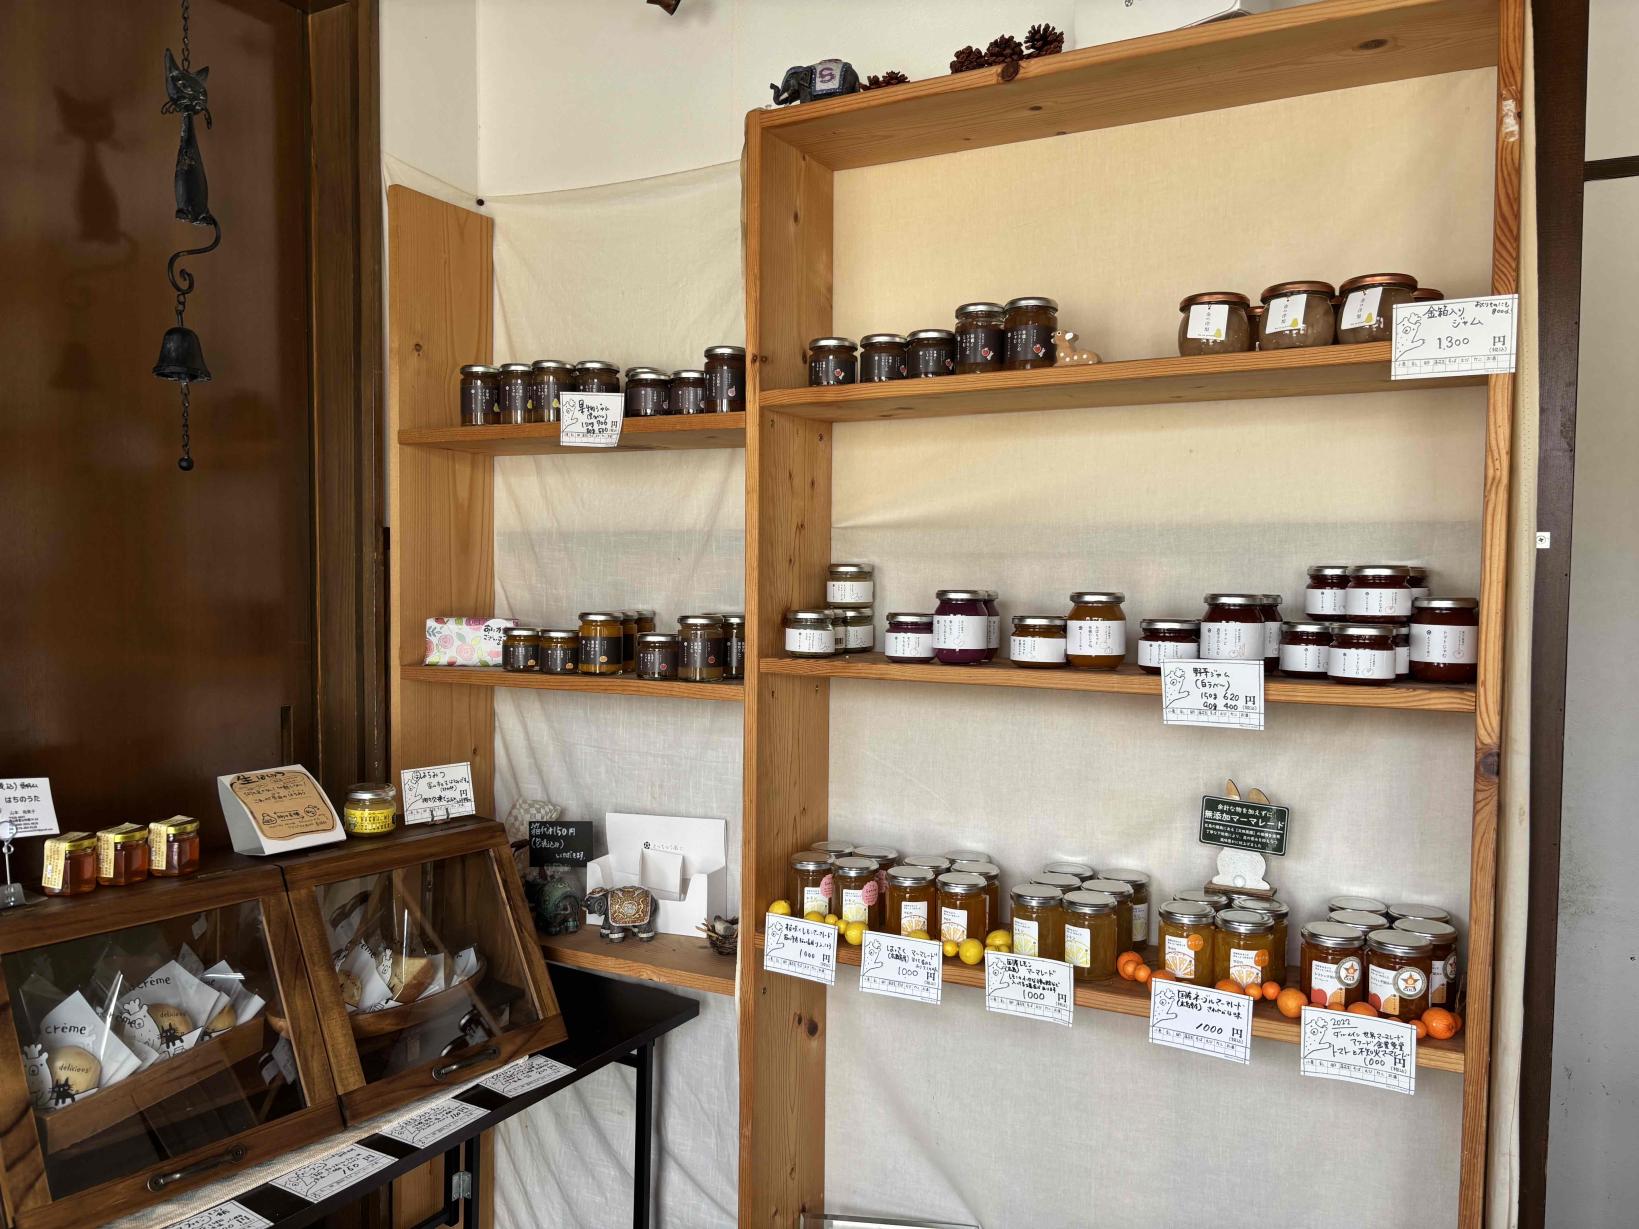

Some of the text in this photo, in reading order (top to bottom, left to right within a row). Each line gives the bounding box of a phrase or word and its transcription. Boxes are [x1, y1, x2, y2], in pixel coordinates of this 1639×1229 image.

[819, 67, 836, 84] S
[1452, 317, 1484, 328] ジャム
[1492, 335, 1506, 346] 円
[611, 420, 618, 428] 円
[1223, 692, 1240, 702] 620
[1245, 695, 1256, 705] 円
[1223, 702, 1239, 711] 400
[5, 795, 41, 804] はちのうた
[1217, 803, 1274, 818] 余計な物を加えずに
[1204, 809, 1285, 829] 無添加マーマレード
[799, 948, 830, 963] 1000 円
[911, 949, 938, 960] マーマレード
[897, 966, 919, 977] 1000
[926, 971, 935, 981] 円
[1026, 968, 1056, 976] マーマレード
[1022, 989, 1067, 1003] 1000 円
[1330, 1018, 1351, 1026] 2022
[44, 1023, 87, 1035] crème
[1195, 1023, 1243, 1039] 1000 円
[1361, 1031, 1405, 1041] 世界マーマレード
[1350, 1038, 1374, 1047] アワード
[1363, 1057, 1406, 1068] 1000 円
[58, 1063, 90, 1074] delicious
